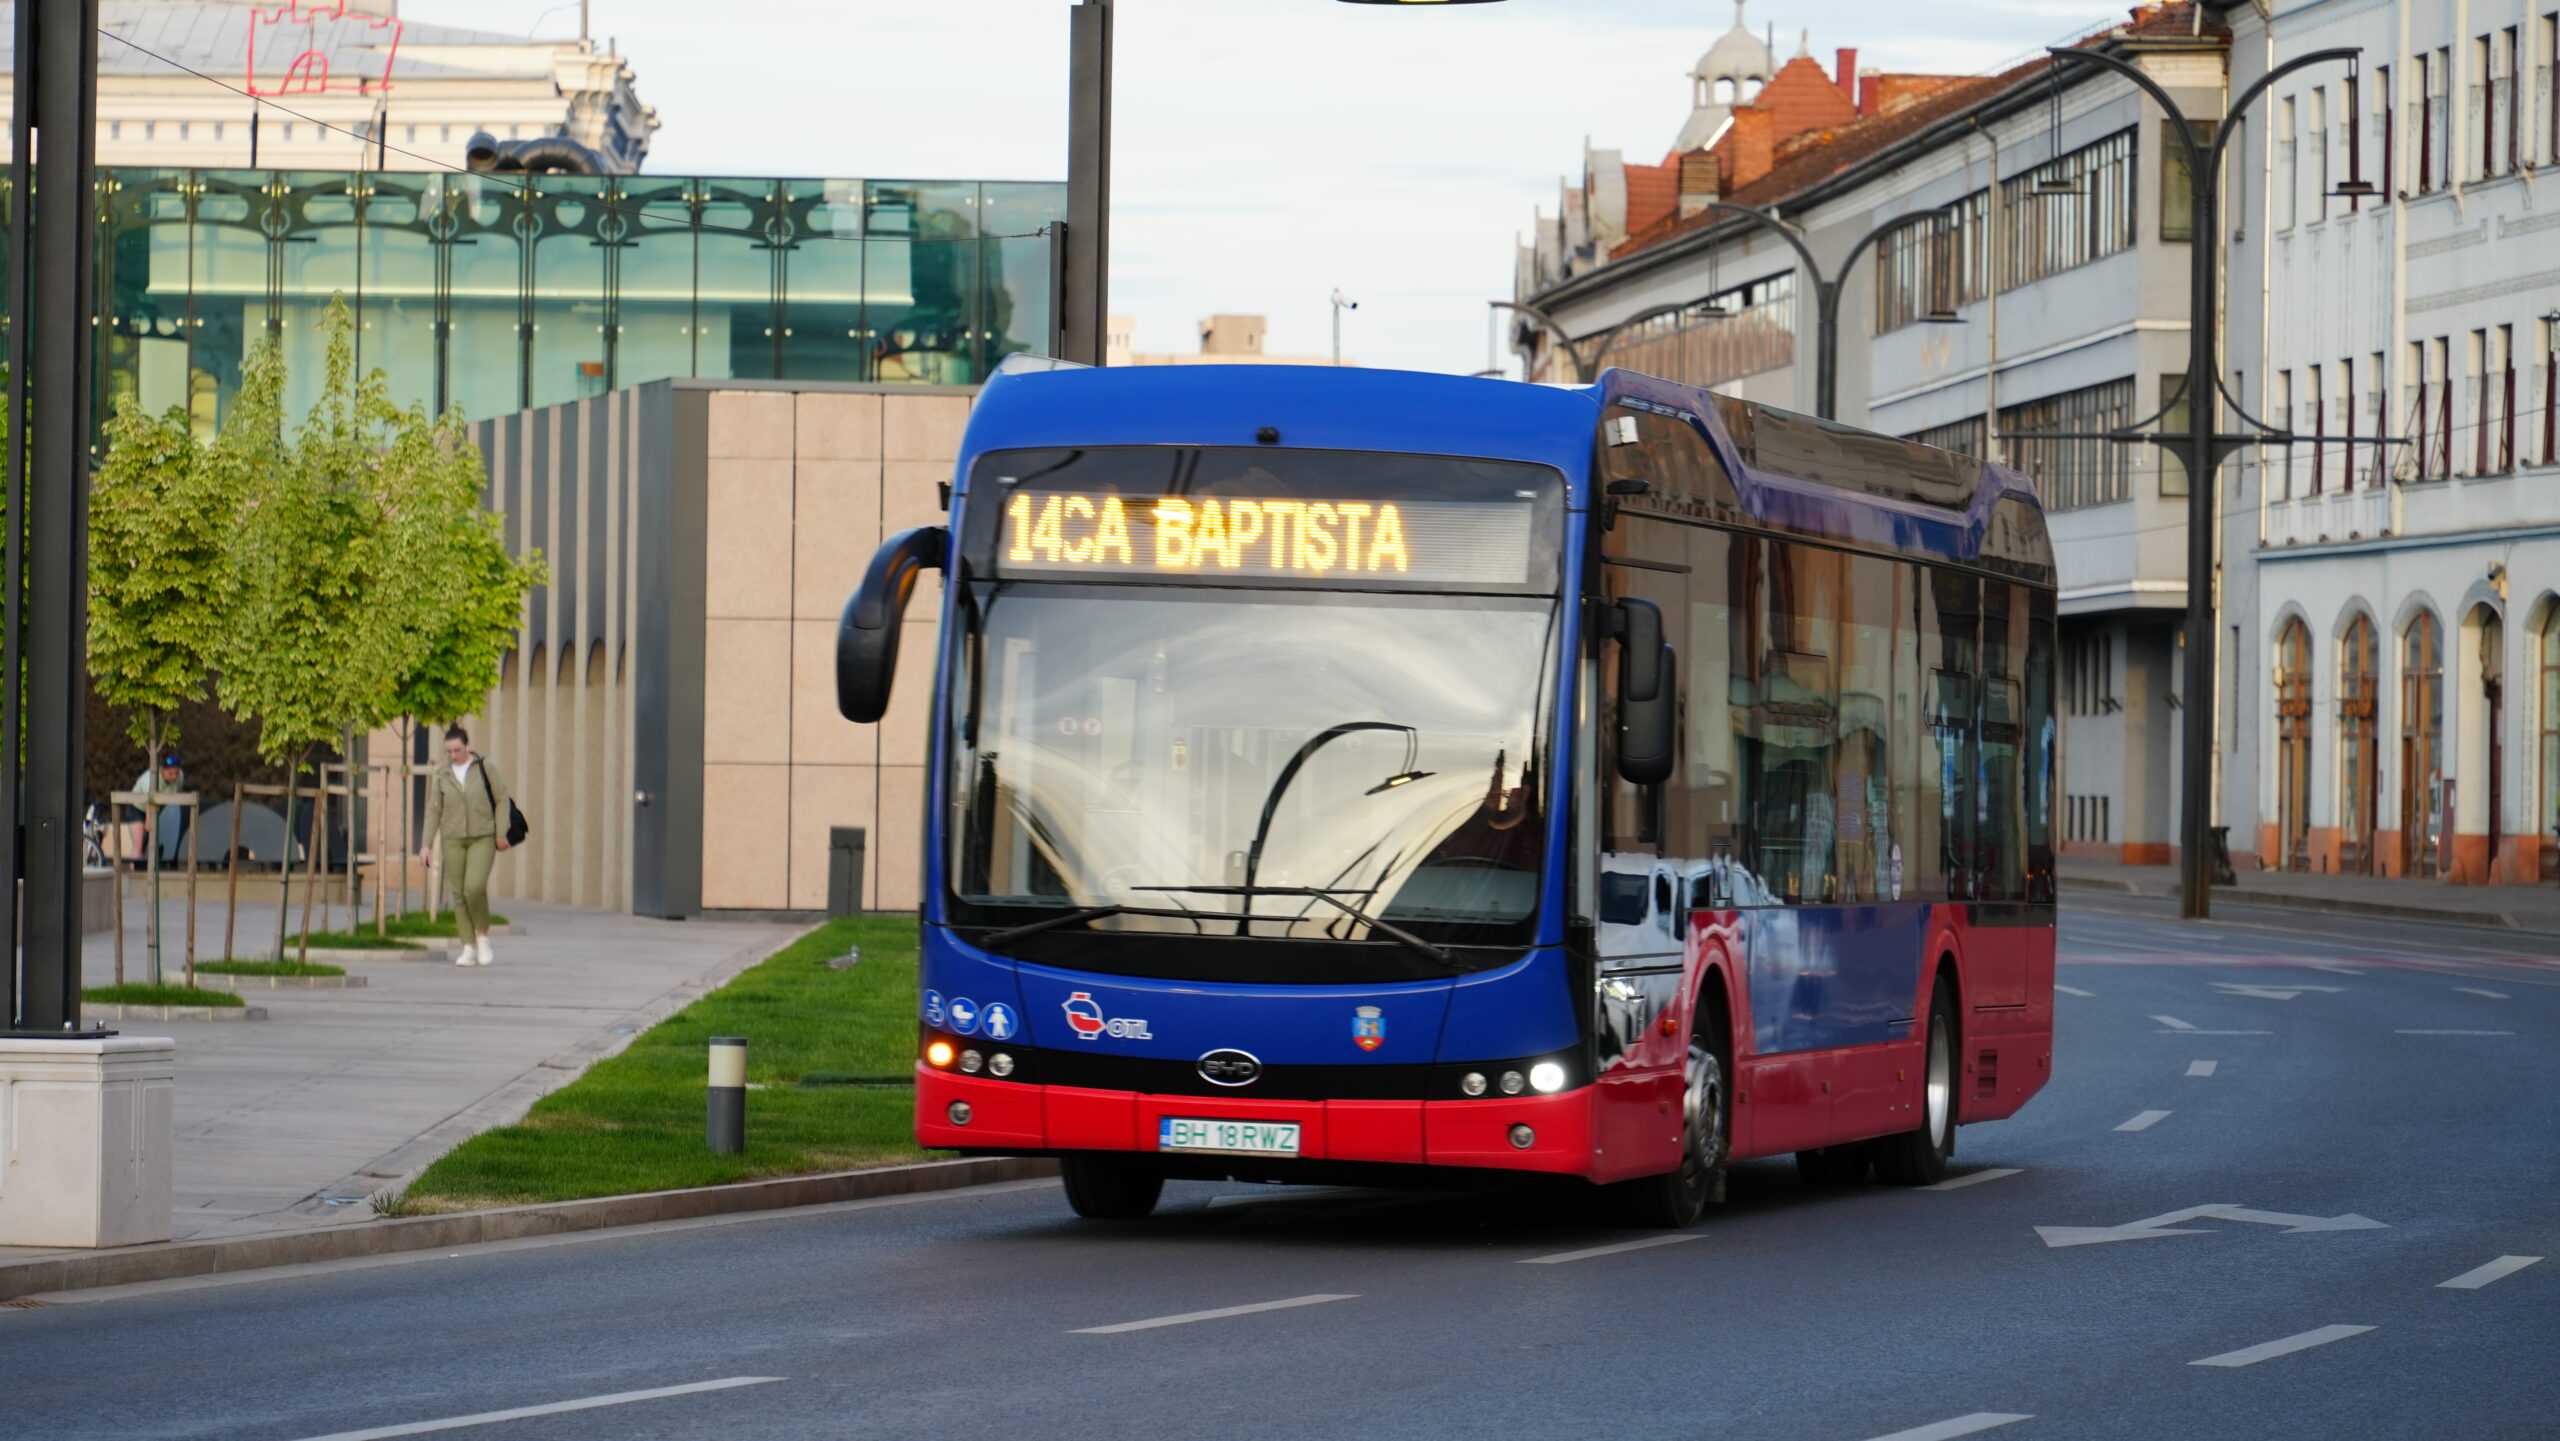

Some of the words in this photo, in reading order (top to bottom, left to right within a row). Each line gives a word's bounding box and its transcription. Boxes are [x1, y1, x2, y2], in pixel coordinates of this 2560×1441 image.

[1155, 498, 1407, 571] BAPTISTA
[1107, 1018, 1153, 1039] OTL
[1204, 1060, 1255, 1076] BYD
[1174, 1122, 1208, 1146] BH
